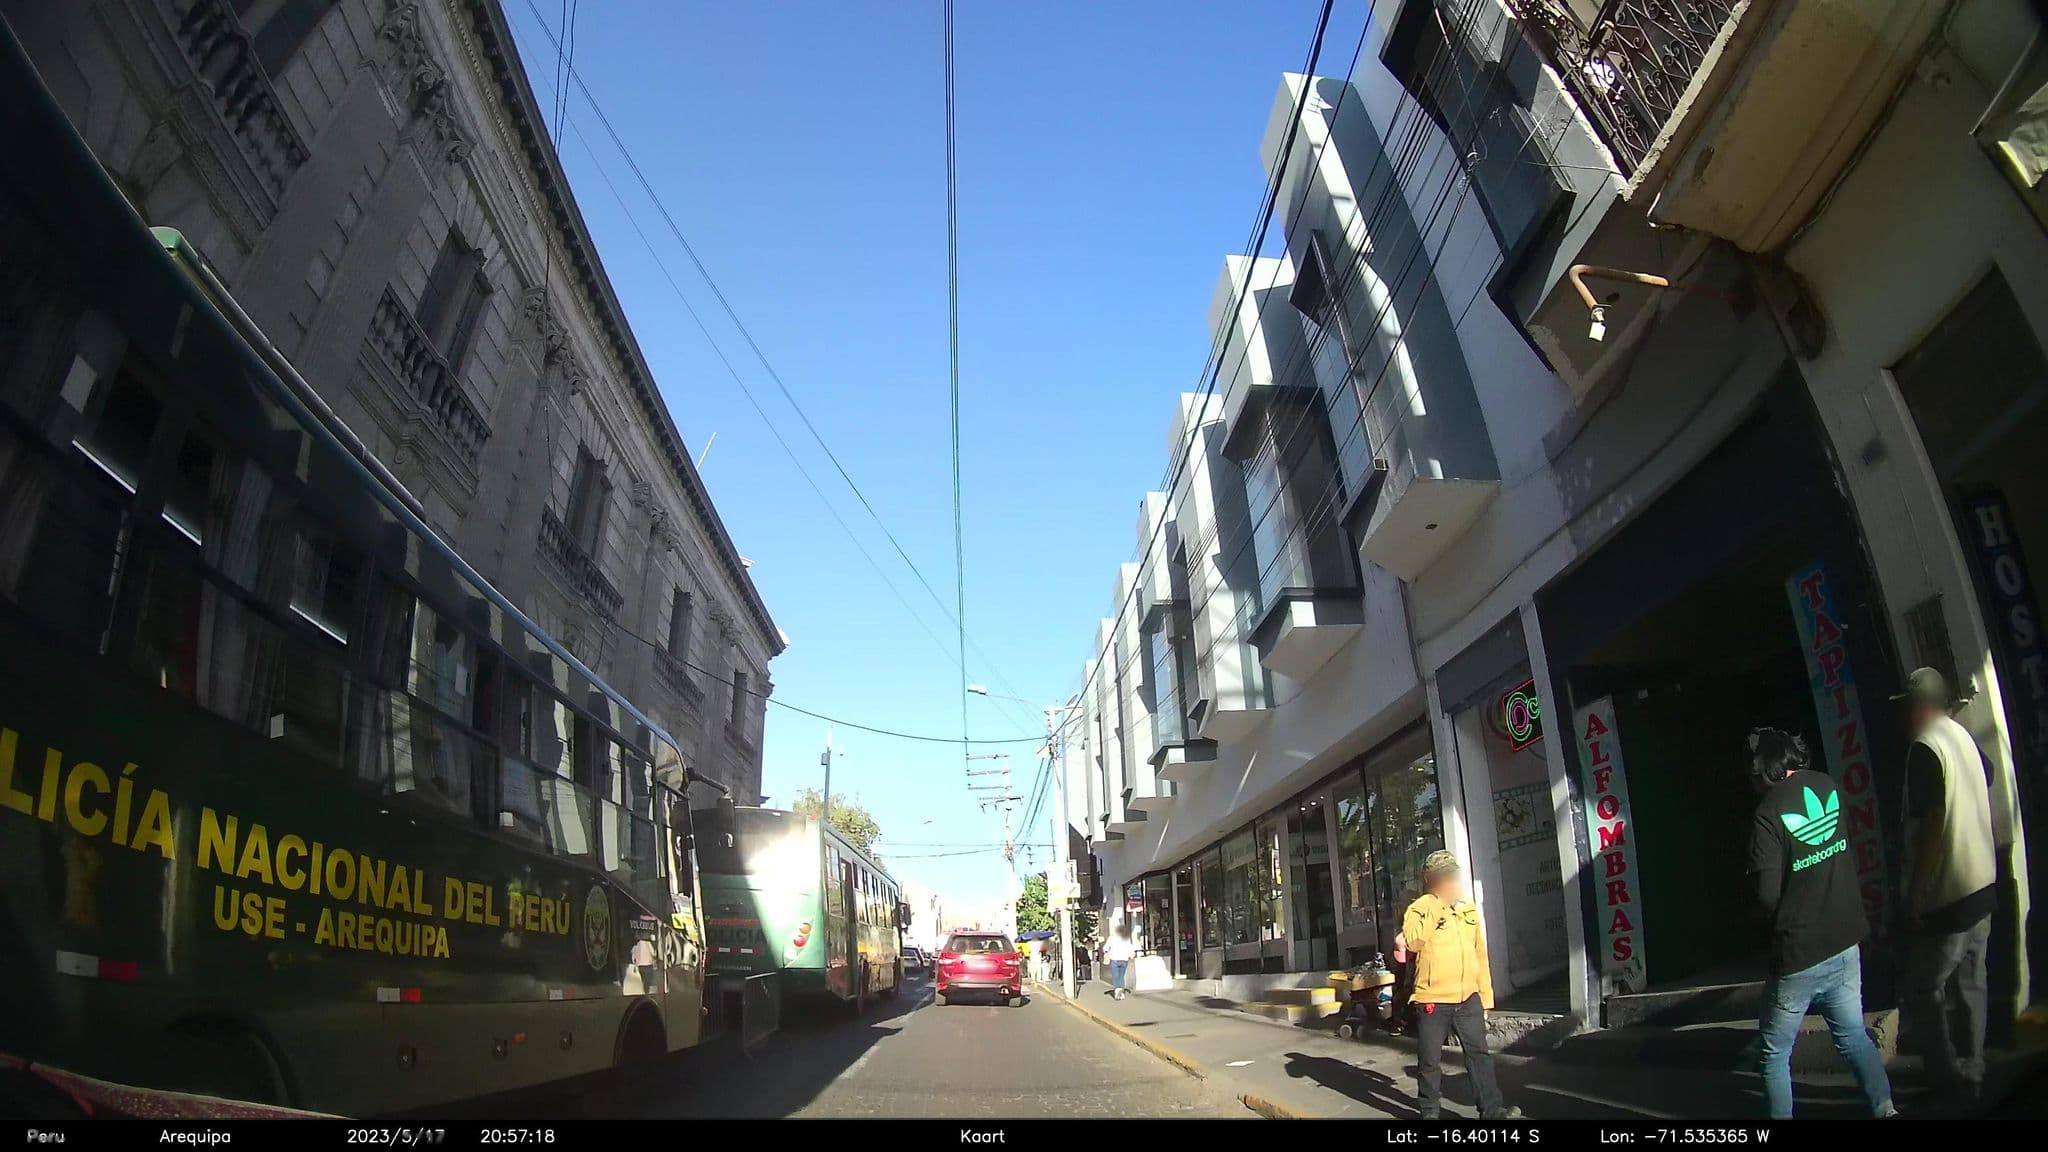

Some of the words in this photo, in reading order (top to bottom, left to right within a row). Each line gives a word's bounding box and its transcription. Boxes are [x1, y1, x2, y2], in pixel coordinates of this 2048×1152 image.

[1799, 570, 1883, 912] TAPIZONES
[197, 807, 432, 916] NACIONAL
[444, 876, 500, 927] DEL
[508, 892, 571, 936] PERÚ
[213, 885, 286, 940] USE
[314, 907, 451, 960] AREQUIPA
[1583, 712, 1633, 963] ALFOMBRAS
